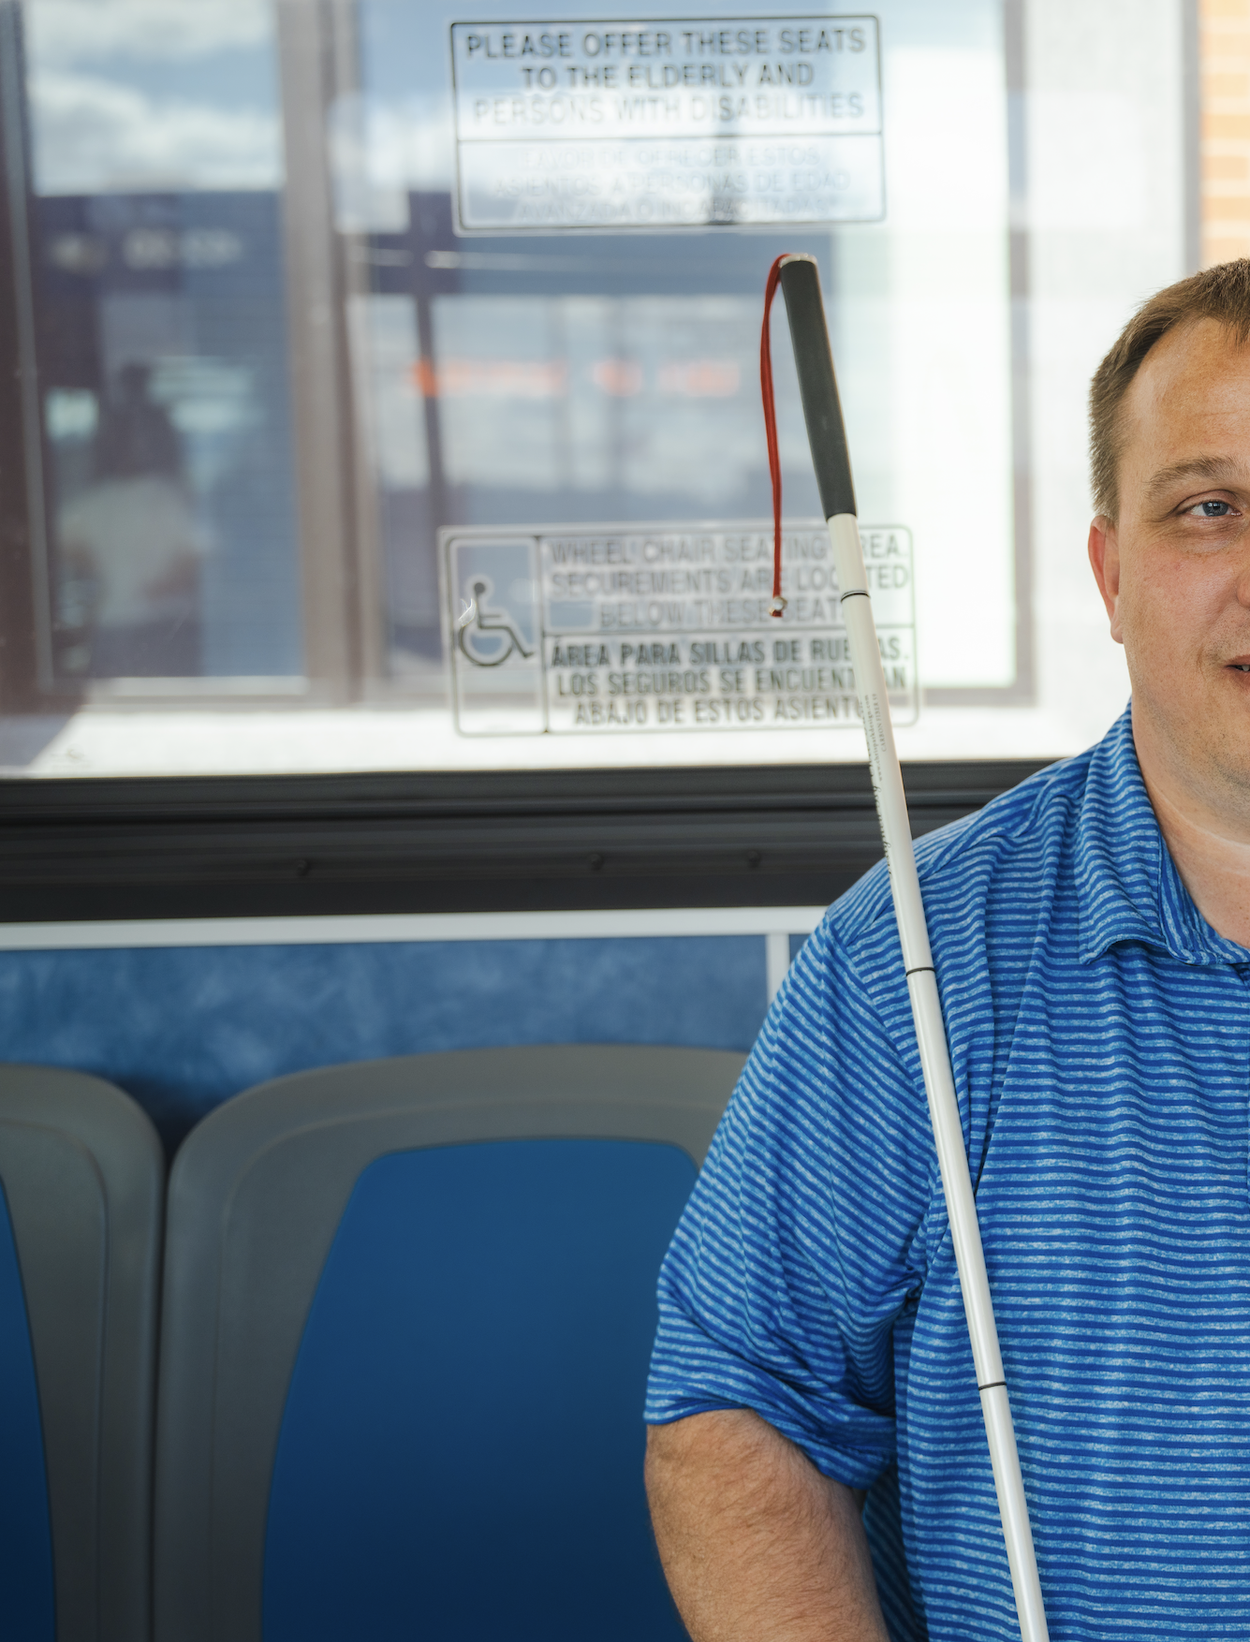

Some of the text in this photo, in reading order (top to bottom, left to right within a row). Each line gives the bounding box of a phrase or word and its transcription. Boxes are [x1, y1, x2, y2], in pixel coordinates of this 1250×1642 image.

[466, 27, 866, 60] PLEASE OFFER THESE SEATS
[521, 61, 814, 90] TO THE ELDERLY AND
[473, 91, 866, 126] PERSONS WITH DISABILITIES
[747, 145, 821, 167] ESTOS
[757, 169, 786, 192] DE
[791, 167, 851, 192] EDAD
[552, 569, 731, 597] SECUREMENTS
[797, 564, 909, 590] LOCTED
[600, 600, 684, 628] BELOW
[694, 598, 769, 625] THESE
[620, 642, 681, 667] PARA
[690, 640, 766, 666] SILLAS
[773, 638, 803, 663] DE
[559, 673, 598, 697] LOS
[608, 670, 710, 697] SEGUROS
[720, 669, 746, 694] SE
[574, 699, 649, 725] ABAJO
[658, 698, 685, 723] DE
[694, 696, 765, 723] ESTOS
[877, 722, 888, 753] CARBON
